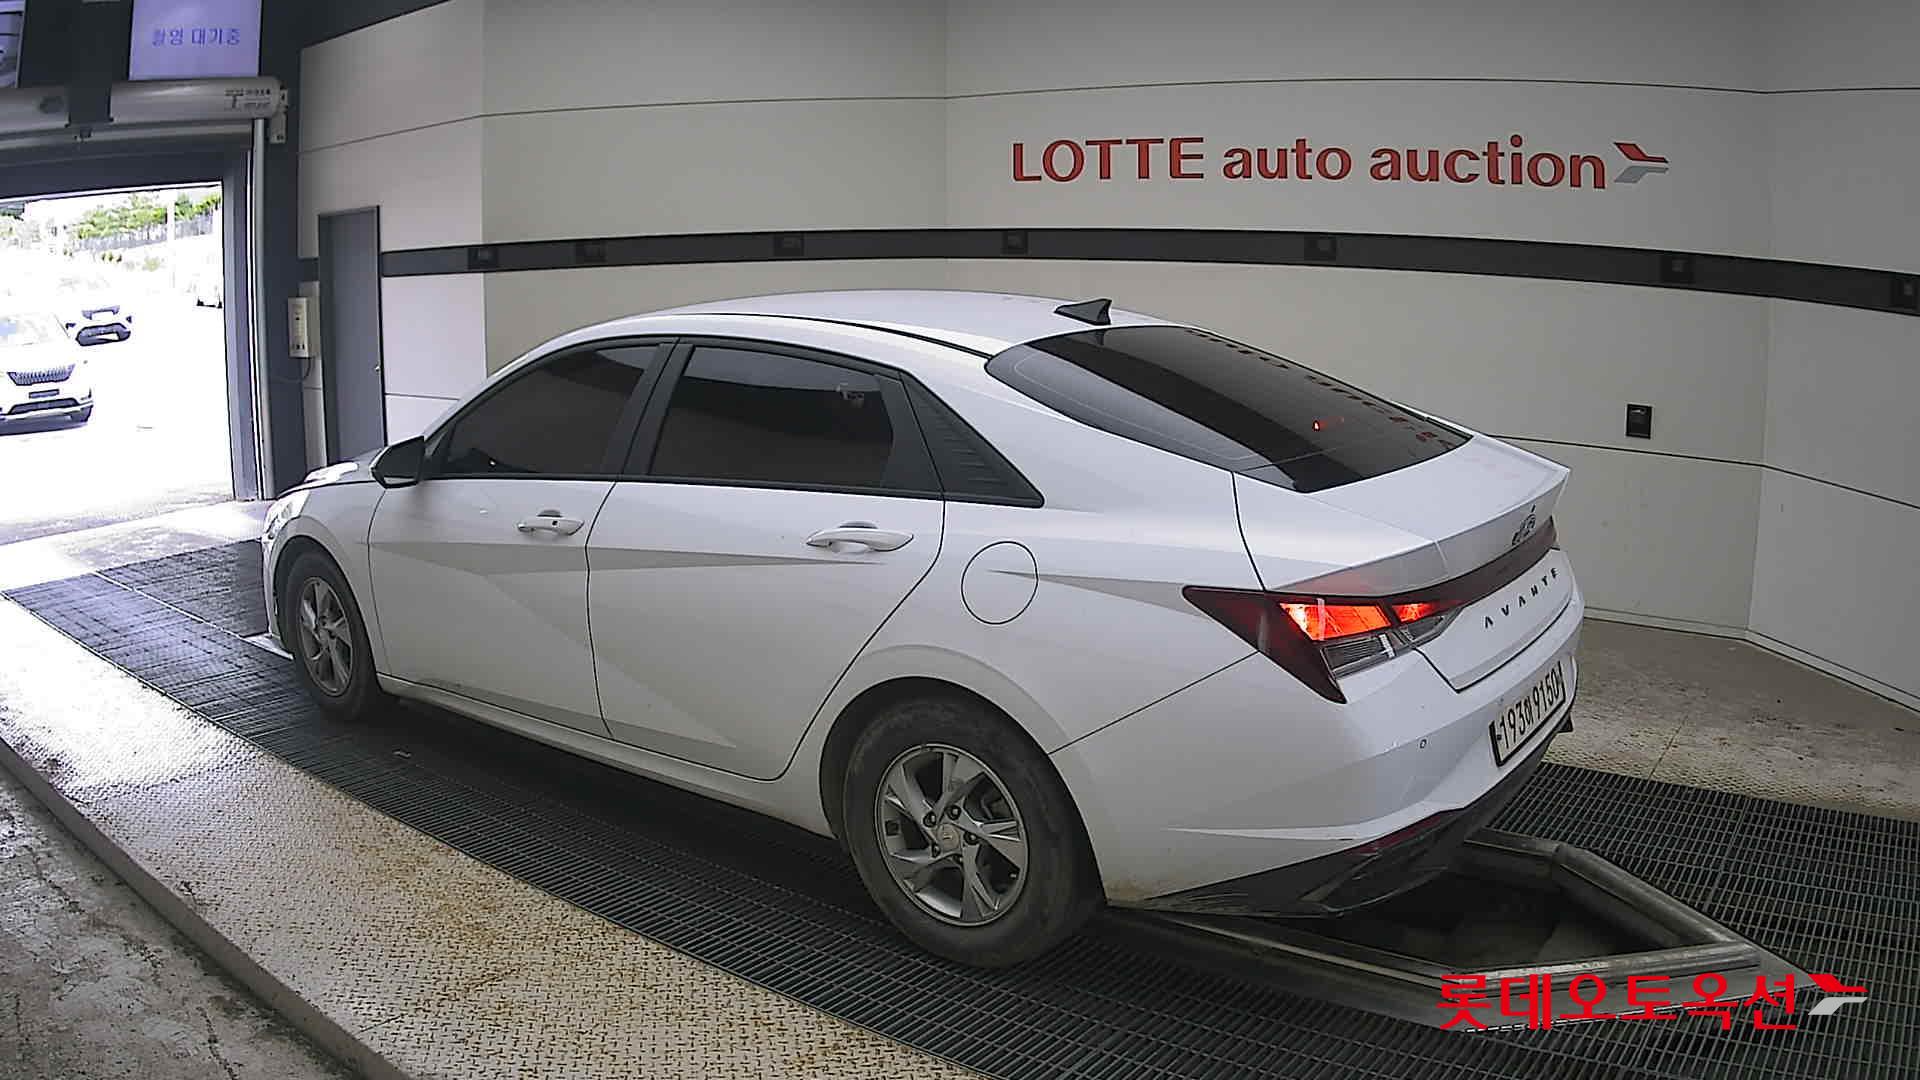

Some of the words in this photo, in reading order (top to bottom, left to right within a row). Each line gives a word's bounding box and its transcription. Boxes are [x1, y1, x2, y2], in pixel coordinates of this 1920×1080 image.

[1012, 137, 1205, 183] LOTTE
[1222, 138, 1353, 181] auto
[1369, 134, 1606, 189] auction
[1484, 567, 1558, 629] AVANTE
